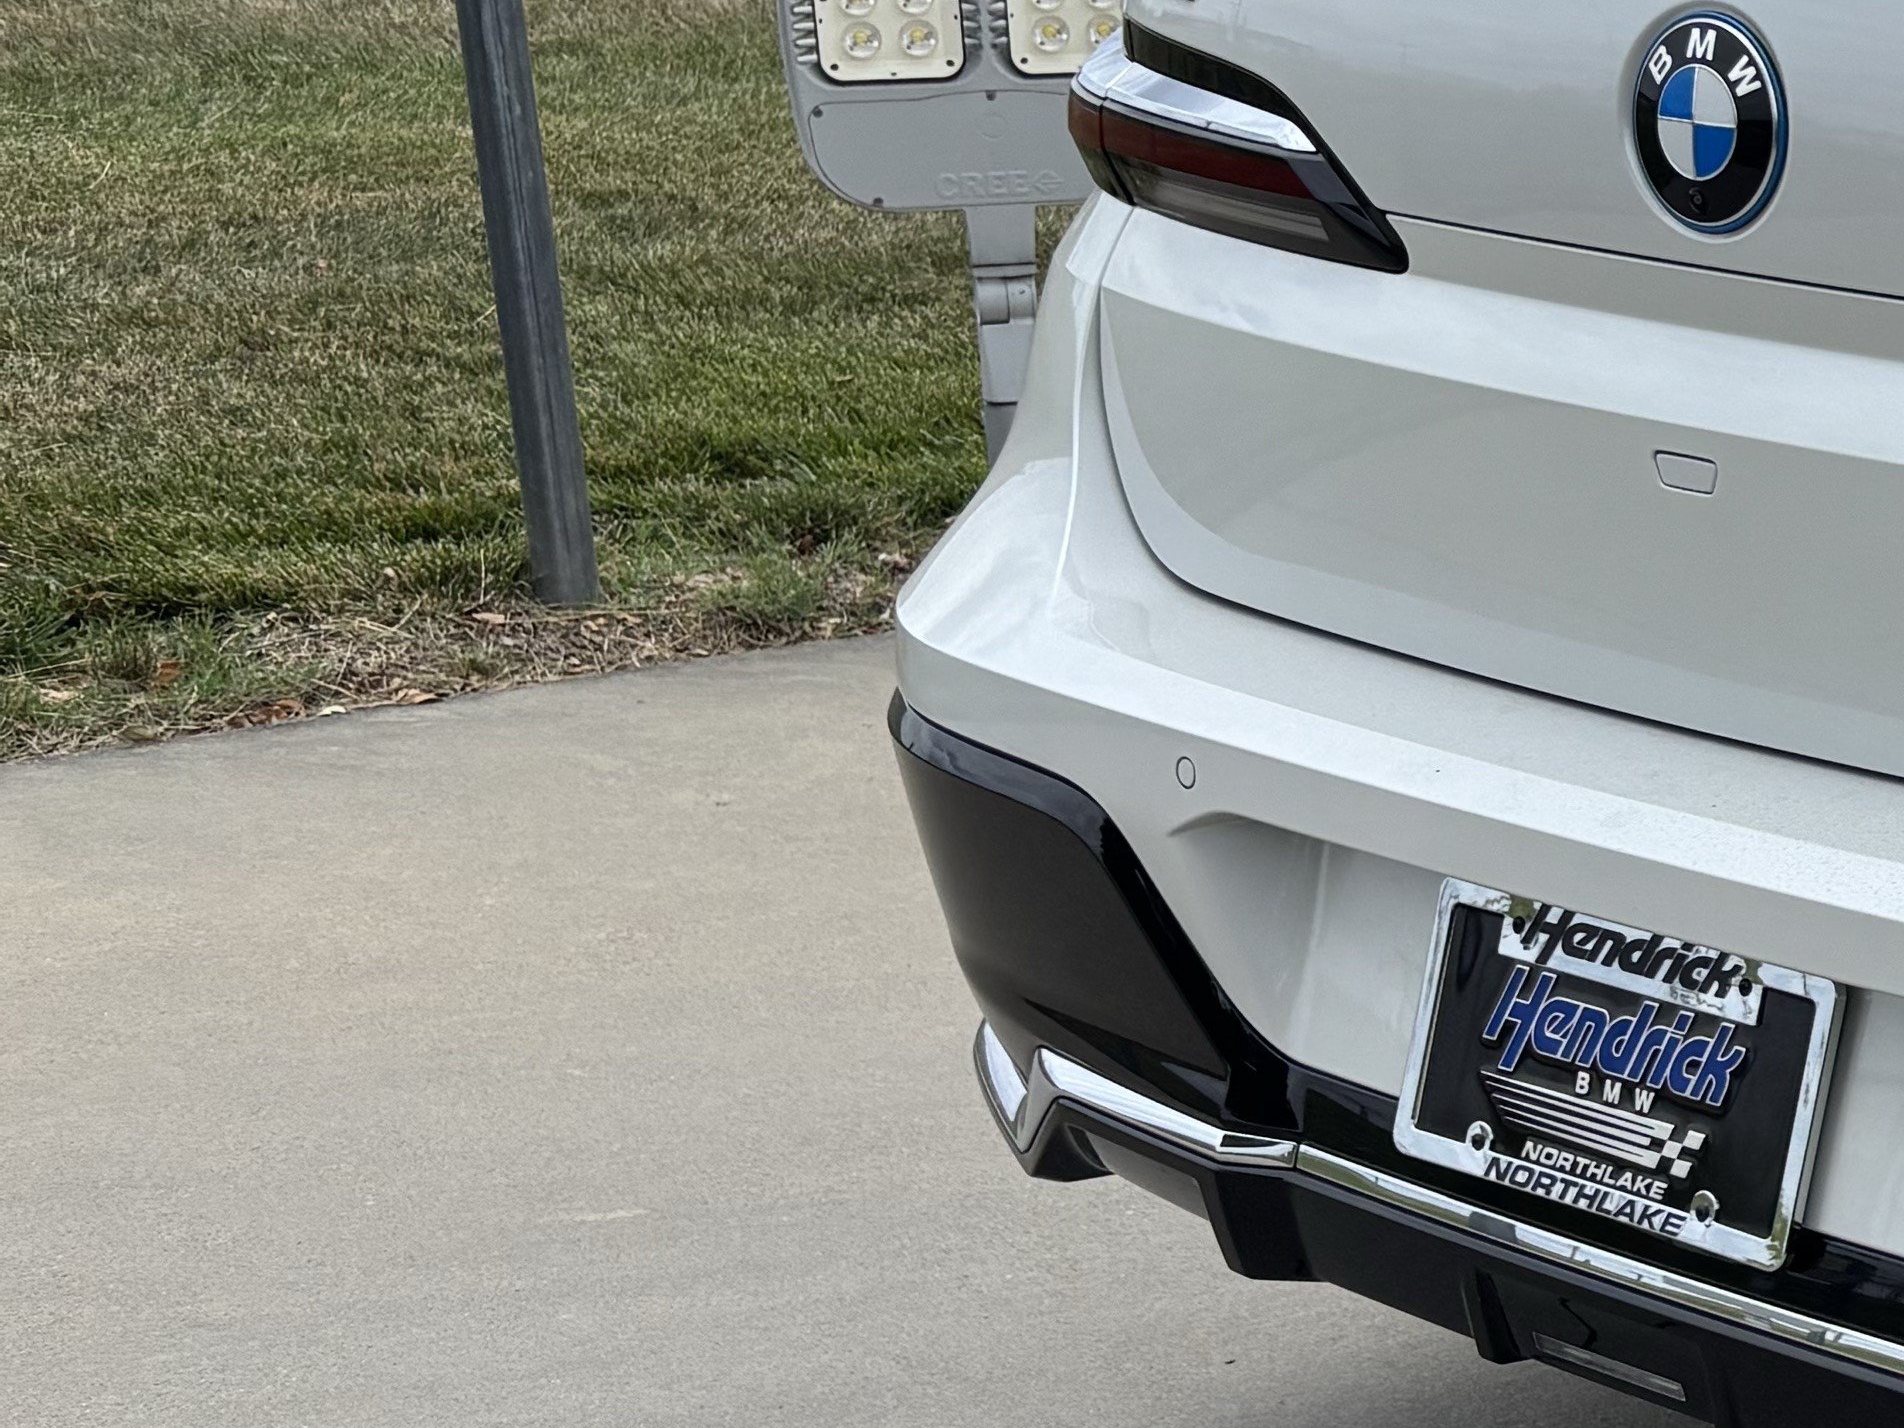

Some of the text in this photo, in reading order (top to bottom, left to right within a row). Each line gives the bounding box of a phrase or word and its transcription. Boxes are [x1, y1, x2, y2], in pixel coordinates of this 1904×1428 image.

[1649, 27, 1762, 98] BMW
[935, 169, 1030, 200] CREE
[1520, 903, 1746, 1000] Hendrick
[1481, 964, 1747, 1108] Hendrick
[1482, 1155, 1688, 1237] NORTHLAKE
[1520, 1140, 1669, 1201] NORTHLAKE
